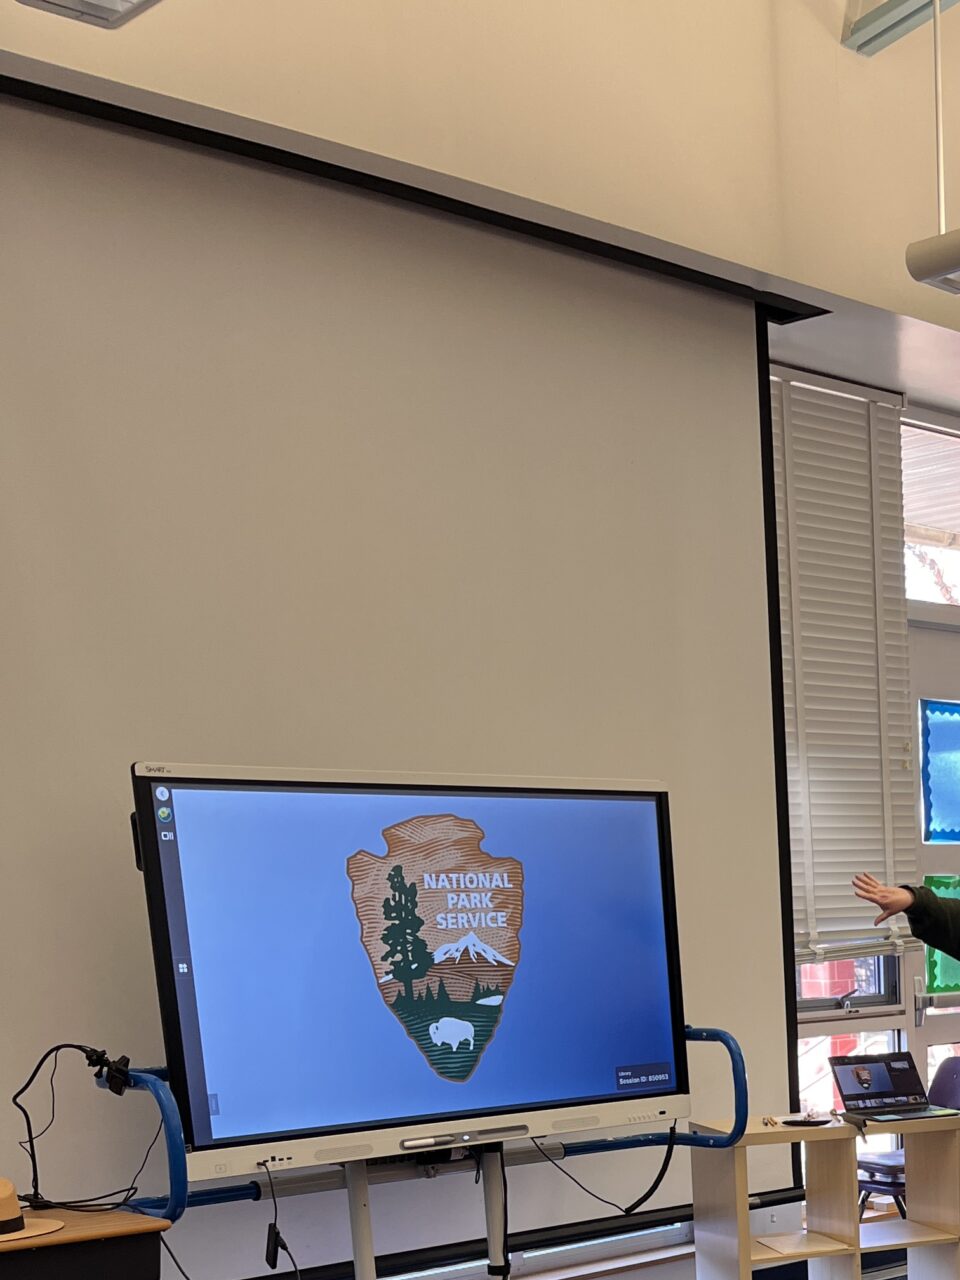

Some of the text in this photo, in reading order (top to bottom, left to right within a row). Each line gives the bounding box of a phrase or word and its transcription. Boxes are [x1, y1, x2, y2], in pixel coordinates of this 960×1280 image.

[423, 873, 513, 889] NATIONAL
[447, 892, 494, 909] PARK
[436, 911, 508, 929] SERVICE
